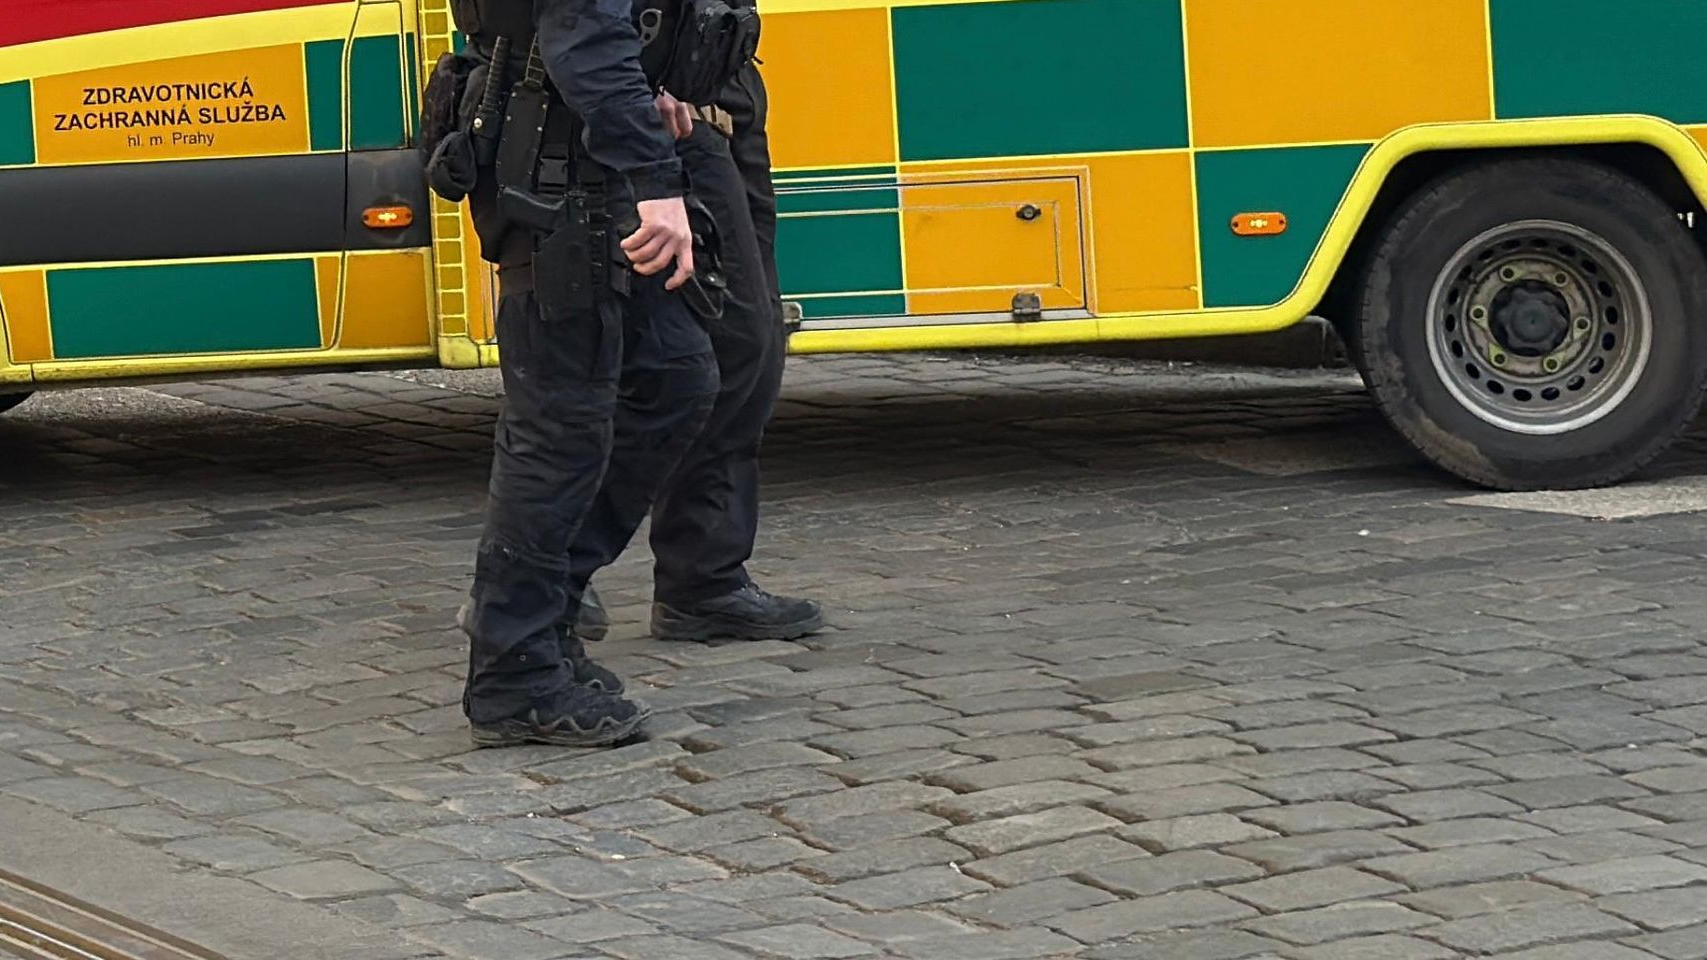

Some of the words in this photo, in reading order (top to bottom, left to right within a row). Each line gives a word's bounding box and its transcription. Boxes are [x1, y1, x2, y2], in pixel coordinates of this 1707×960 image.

[83, 76, 253, 106] ZDRAVOTNICKÁ
[198, 101, 286, 125] SLUŽBA
[172, 132, 215, 147] Prahy
